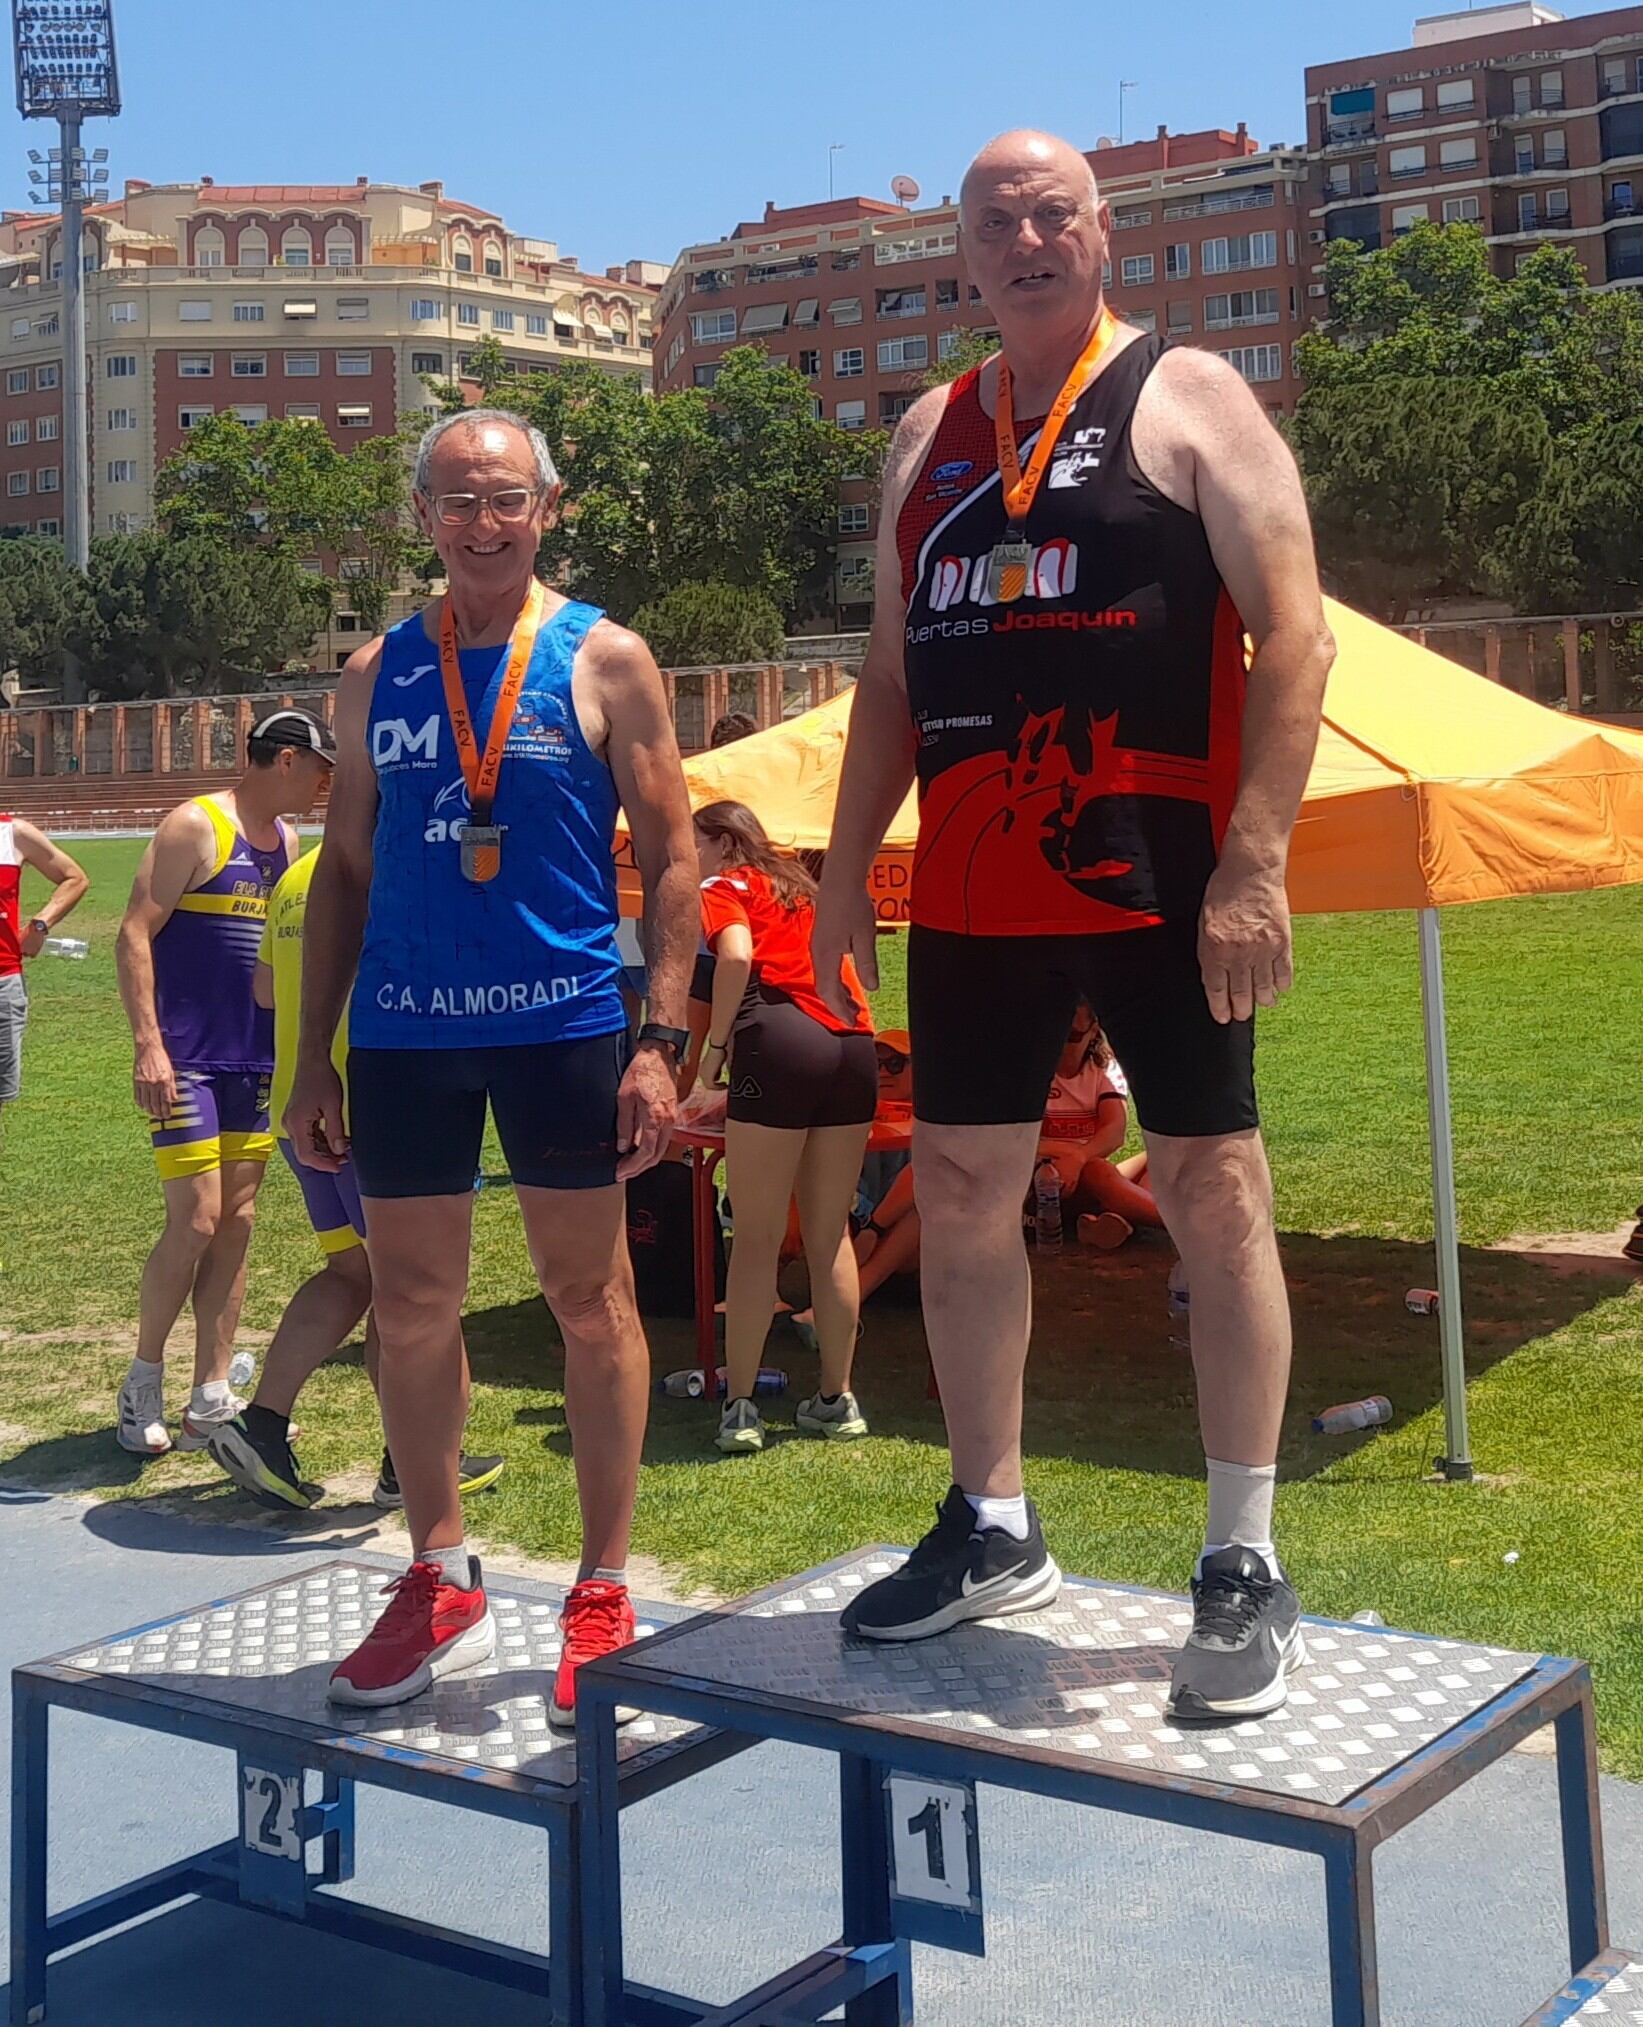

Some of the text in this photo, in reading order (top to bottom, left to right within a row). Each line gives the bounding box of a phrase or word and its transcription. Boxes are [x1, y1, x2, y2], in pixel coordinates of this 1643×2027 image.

[1052, 382, 1078, 417] FACV
[1000, 434, 1014, 469] FACV
[1018, 466, 1040, 505] FACV
[906, 617, 989, 647] Puertas
[503, 659, 523, 697] FACV
[453, 709, 471, 747] FACV
[945, 714, 993, 729] PROMESAS
[373, 714, 440, 767] DM
[502, 743, 572, 756] IKILOMETROS
[481, 746, 499, 786] FACV
[232, 880, 258, 898] ELS
[867, 864, 908, 888] ED
[376, 983, 422, 1014] C.A.
[259, 1778, 283, 1848] 2
[907, 1797, 946, 1881] 1
